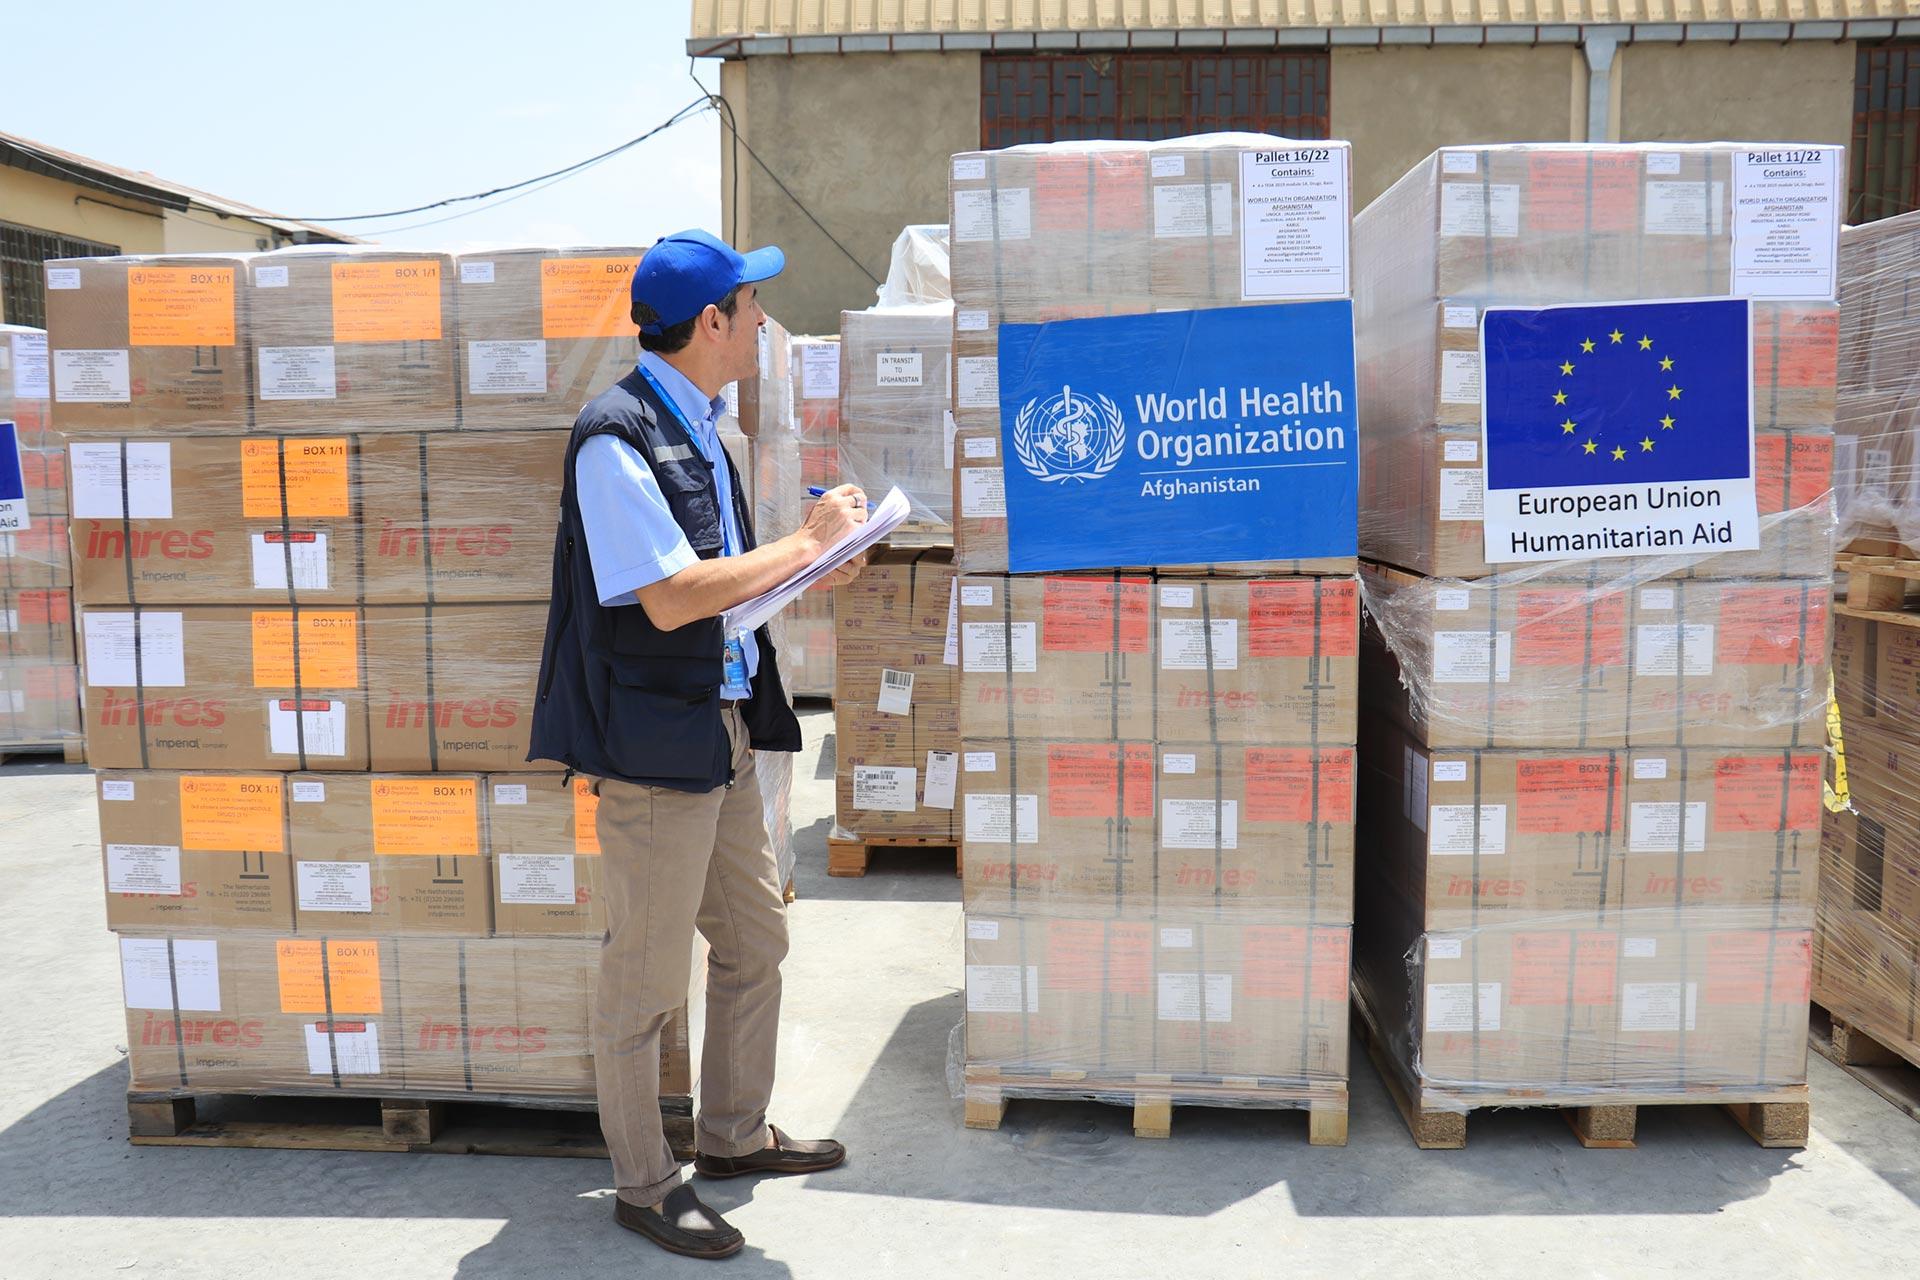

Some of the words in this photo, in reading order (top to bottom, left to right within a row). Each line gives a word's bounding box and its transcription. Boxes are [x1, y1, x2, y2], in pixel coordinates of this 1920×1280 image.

[1255, 151, 1290, 163] Pallet
[1294, 149, 1330, 163] 16/22
[1747, 151, 1782, 163] Pallet
[1786, 150, 1821, 164] 11/22
[1271, 167, 1315, 177] Contains:
[1763, 168, 1807, 178] Contains:
[1247, 196, 1270, 204] WORLD
[1270, 195, 1292, 203] HEALTH
[1292, 194, 1337, 202] ORGANIZATION
[1271, 203, 1313, 211] AFGHANISTAN
[395, 268, 418, 278] BOX
[423, 268, 436, 278] 1/1
[606, 263, 630, 274] BOX
[190, 273, 213, 284] BOX
[217, 273, 230, 284] 1/1
[881, 357, 889, 365] IN
[889, 357, 914, 365] TRANSIT
[894, 366, 903, 374] TO
[880, 375, 919, 384] AFGHANISTAN
[1135, 386, 1228, 425] World
[1240, 380, 1344, 418] Health
[1136, 420, 1345, 467] Organization
[303, 446, 326, 456] BOX
[329, 446, 344, 456] 1/1
[1140, 475, 1261, 500] Afghanistan
[1518, 490, 1638, 518] European
[1647, 485, 1721, 510] Union
[86, 519, 215, 560] imres
[377, 518, 513, 558] imres
[1511, 524, 1685, 554] Humanitarian
[1691, 520, 1733, 546] Aid
[141, 570, 187, 583] Imperial
[436, 568, 482, 580] Imperial
[1338, 588, 1354, 598] 4/6
[313, 618, 336, 628] BOX
[339, 618, 353, 628] 1/1
[914, 654, 925, 665] M
[100, 688, 226, 728] imres
[385, 688, 518, 729] imres
[155, 737, 200, 750] Imperial
[442, 739, 490, 752] Imperial
[1334, 755, 1350, 765] 5/6
[1578, 764, 1602, 774] BOX
[240, 783, 262, 793] BOX
[266, 784, 279, 794] 1/1
[433, 786, 456, 796] BOX
[459, 787, 473, 797] 1/1
[427, 887, 465, 895] Netherlands
[336, 947, 360, 957] BOX
[362, 948, 376, 957] 1/1
[141, 1011, 263, 1048] imres
[417, 1015, 547, 1051] imres
